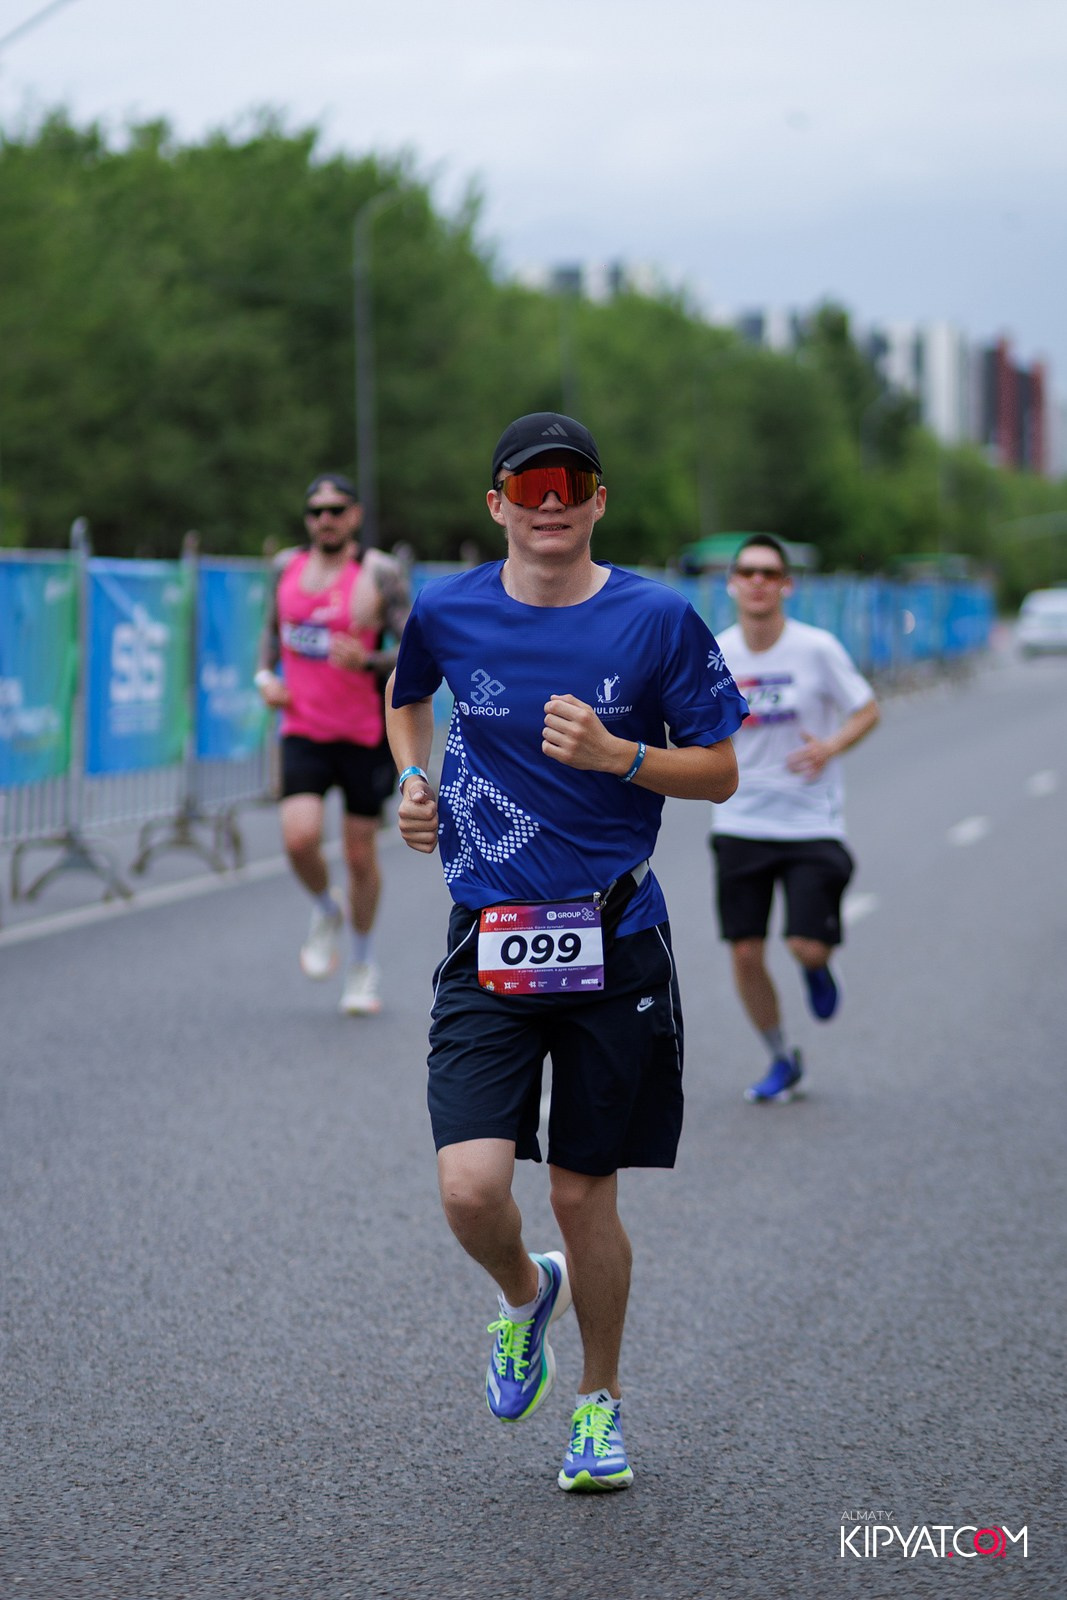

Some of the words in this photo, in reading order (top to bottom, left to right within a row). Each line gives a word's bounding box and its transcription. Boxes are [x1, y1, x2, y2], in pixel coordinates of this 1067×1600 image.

[470, 705, 510, 717] GROUP
[485, 911, 498, 924] 10
[500, 912, 517, 923] KM
[558, 911, 581, 919] GROUP
[500, 932, 582, 966] 099
